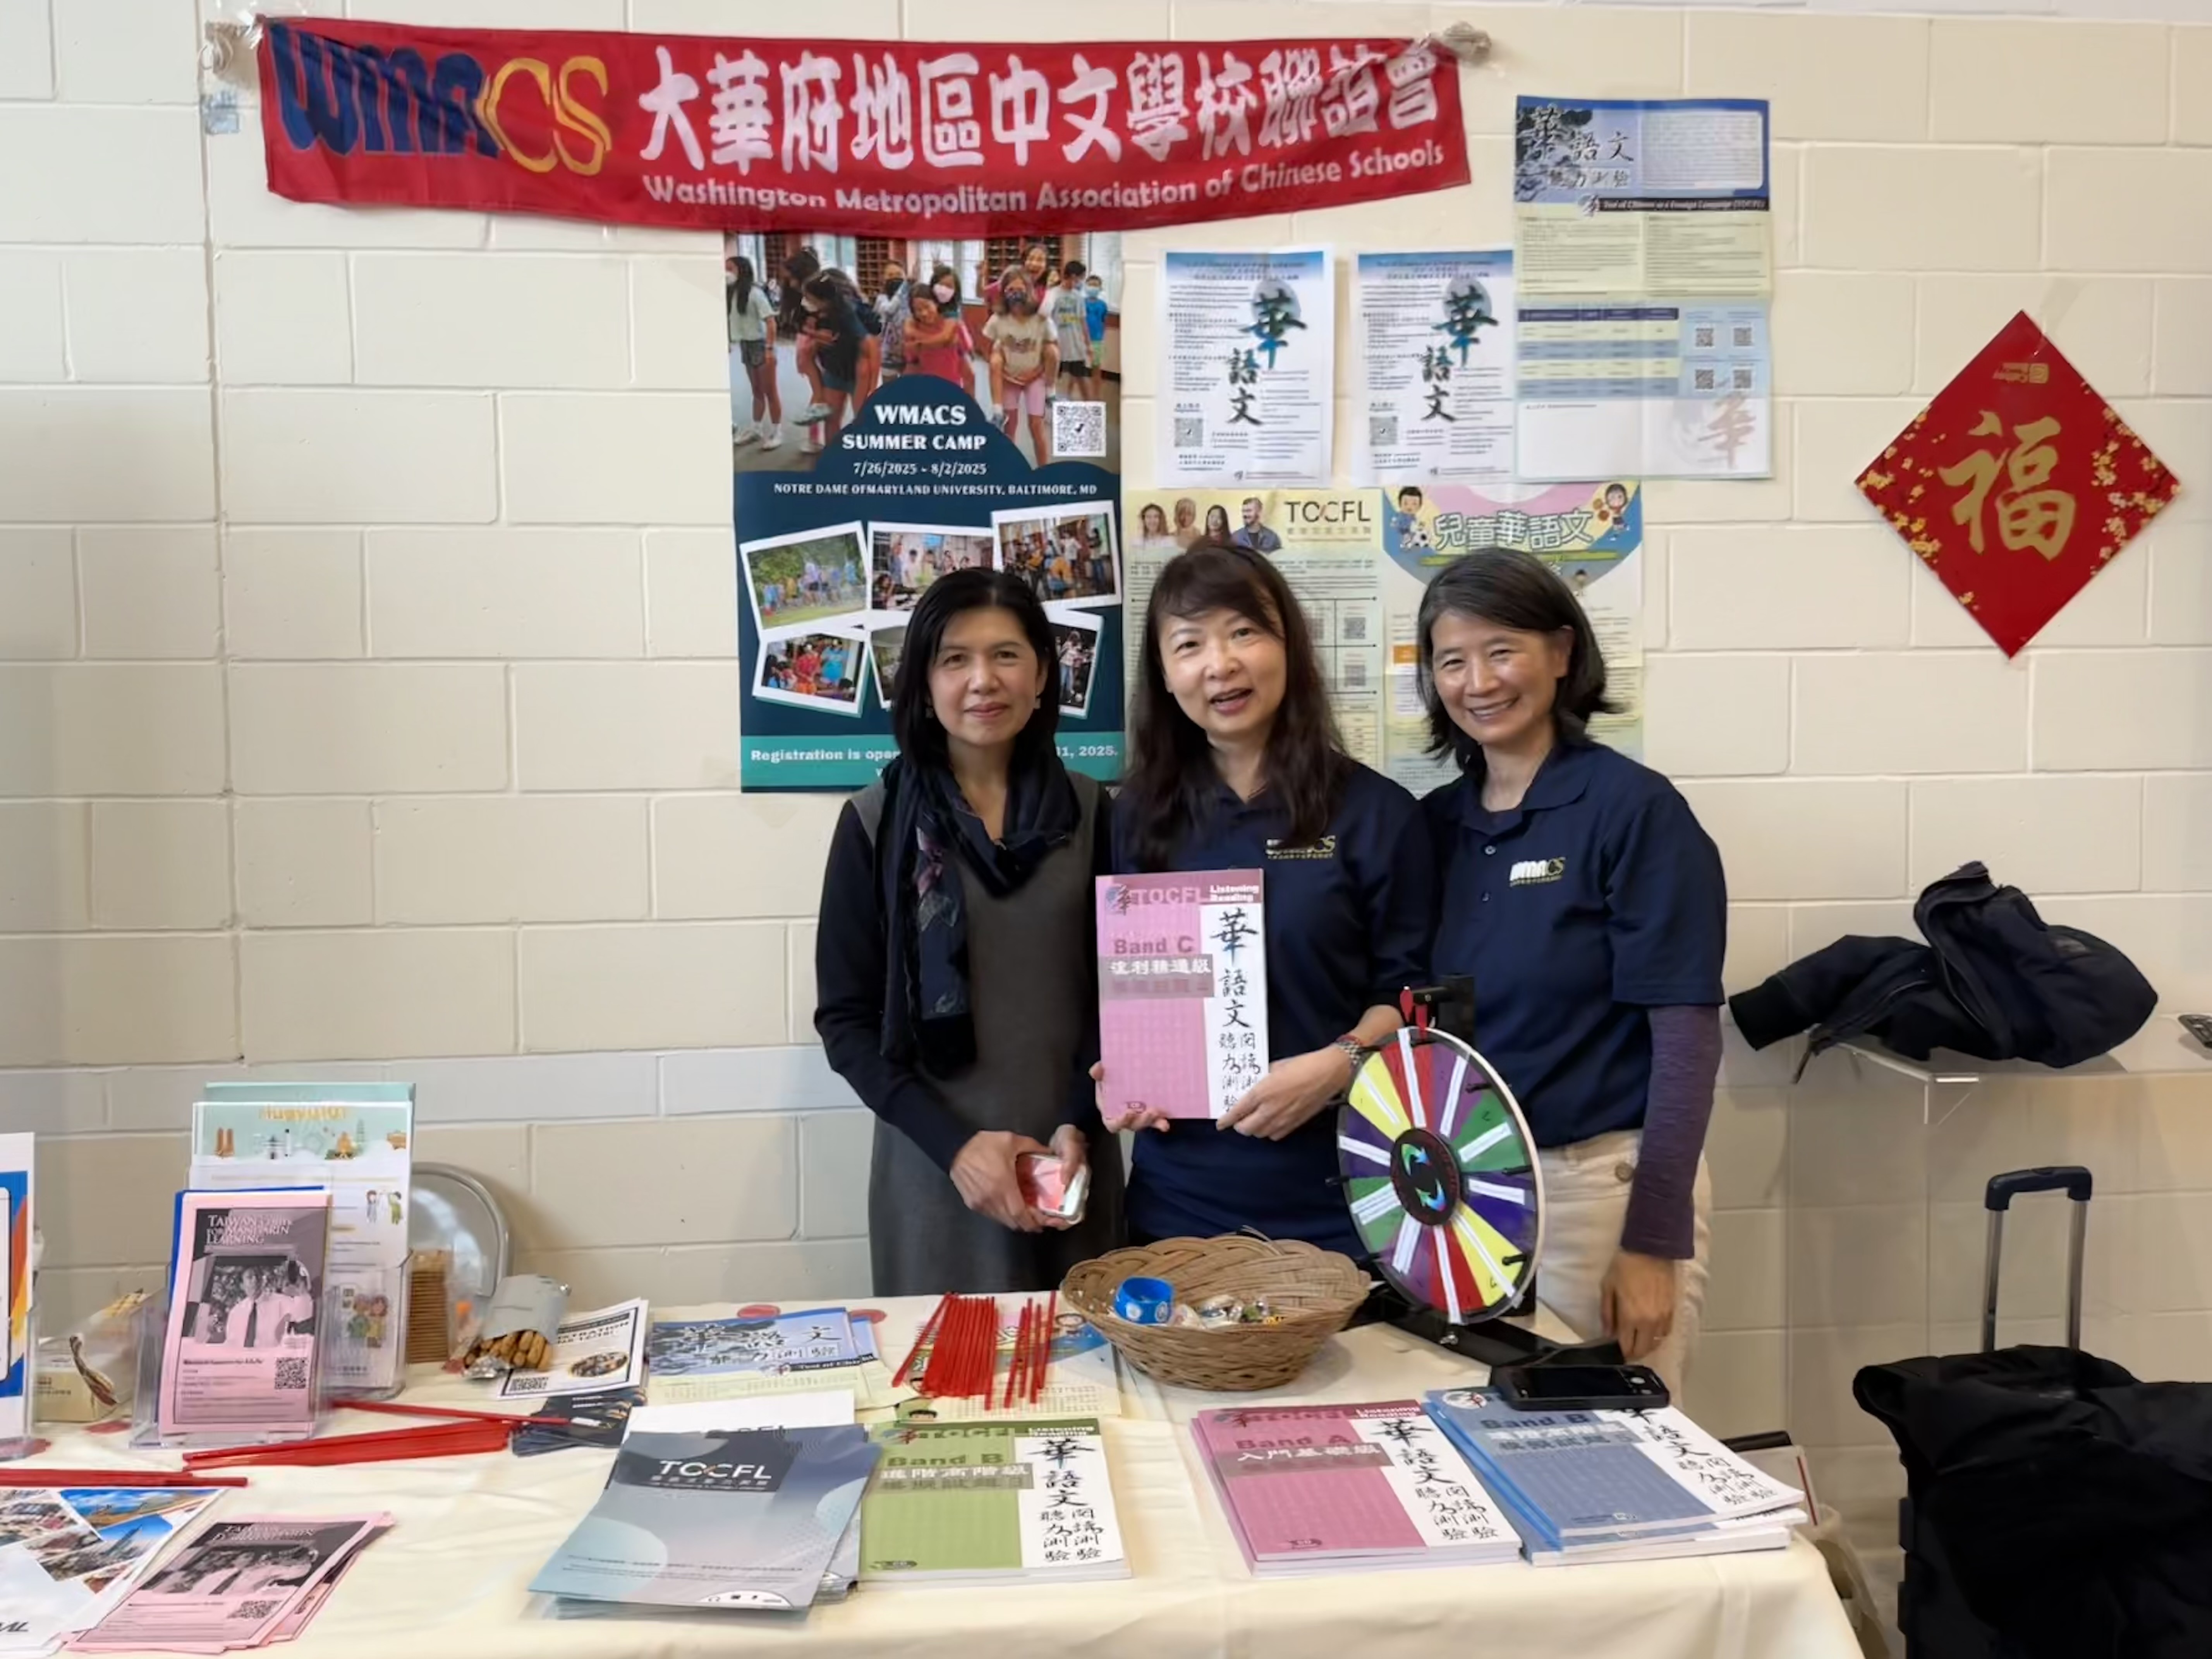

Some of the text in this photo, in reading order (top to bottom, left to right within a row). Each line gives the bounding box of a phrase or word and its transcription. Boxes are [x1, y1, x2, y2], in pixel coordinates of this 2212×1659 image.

[642, 139, 1444, 219] Washington Metropolitan Association of Chinese Schools
[874, 405, 967, 426] WMACS
[842, 434, 987, 450] SUMMER CAMP
[853, 460, 918, 478] 7/26/2025
[931, 461, 987, 478] 8/2/2025
[774, 483, 812, 494] NOTRE
[815, 484, 848, 495] DAME
[851, 484, 931, 495] OFMARYLAND
[933, 484, 1006, 496] UNIVERSITY,
[1079, 484, 1097, 495] MD
[1937, 409, 2076, 562] 福
[1285, 501, 1371, 523] TOCFL
[1434, 509, 1594, 551] 兒童華語文
[750, 749, 843, 764] Registration
[847, 748, 860, 760] is
[1114, 935, 1194, 954] Band C
[1209, 907, 1259, 1029] 華語文
[1480, 1417, 1556, 1429] Band
[1237, 1434, 1352, 1450] Band A
[1370, 1419, 1457, 1484] 華語文
[659, 1460, 773, 1480] TOCFL
[887, 1453, 1004, 1467] Band B
[1027, 1438, 1096, 1508] 華語文
